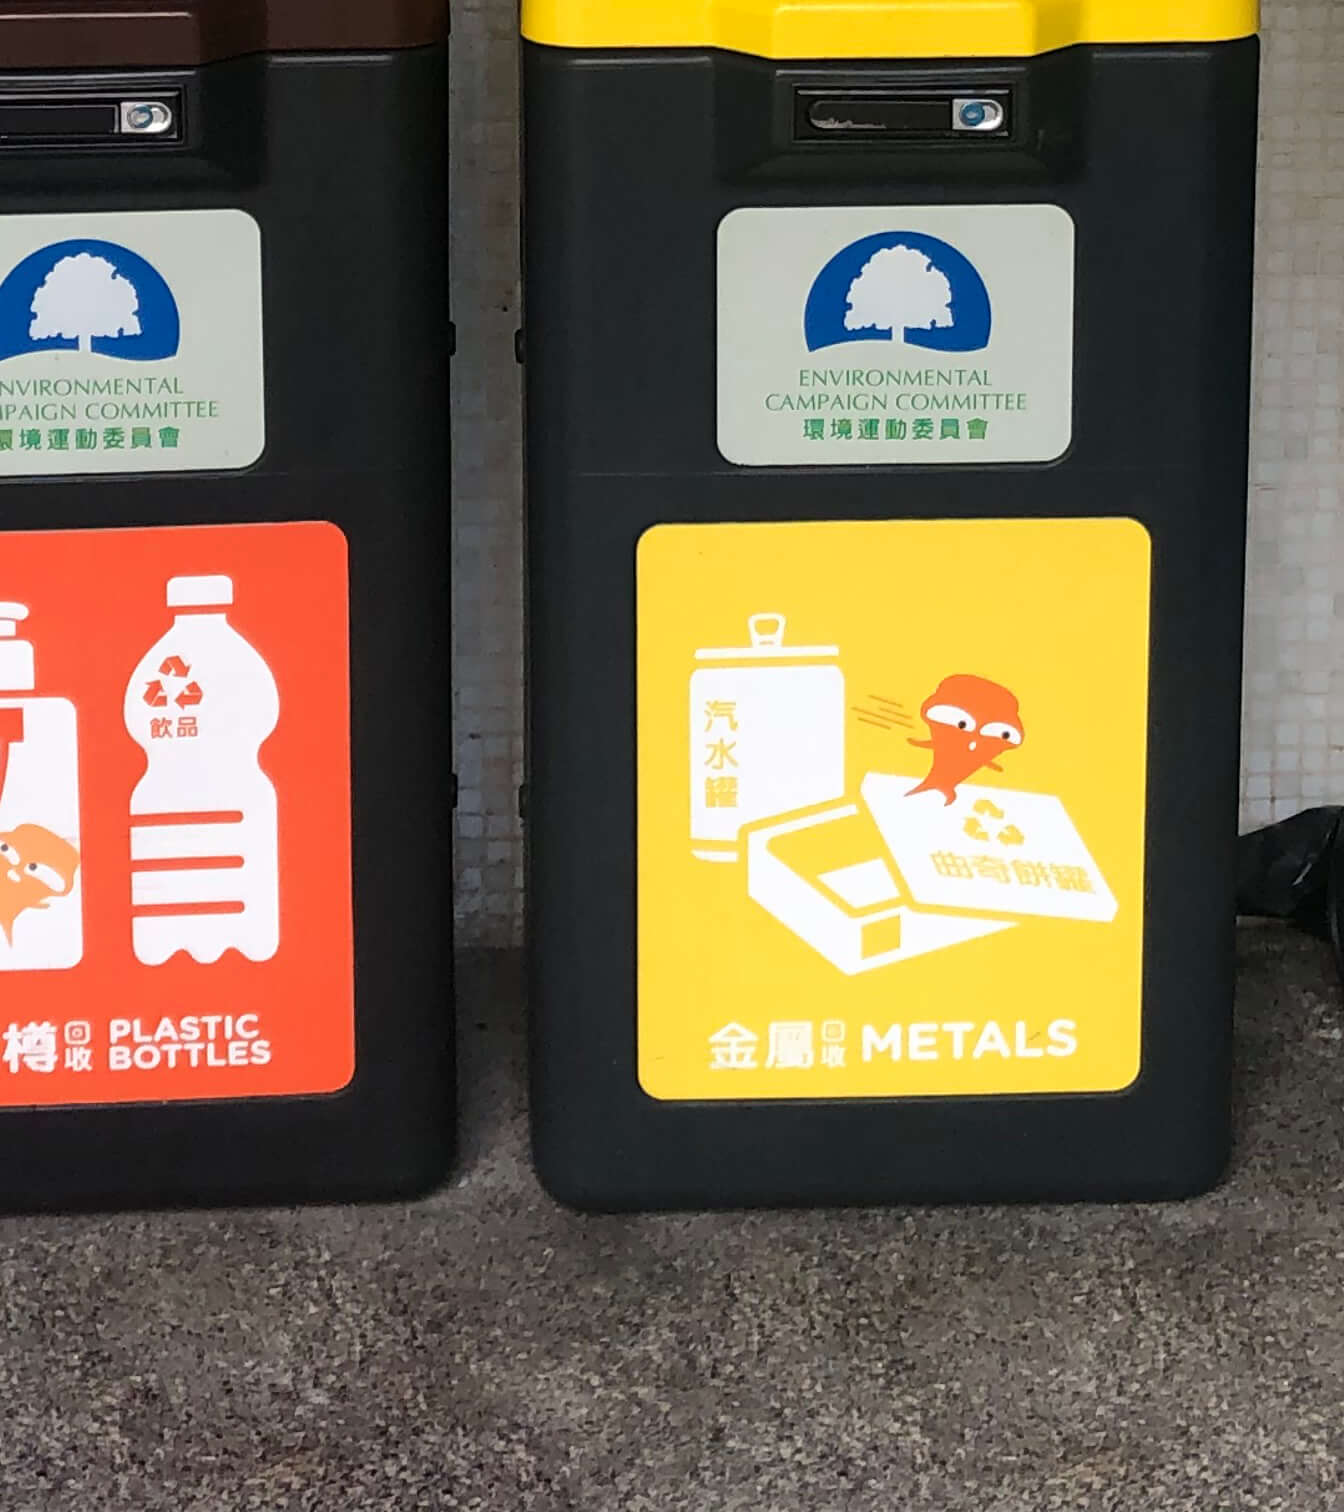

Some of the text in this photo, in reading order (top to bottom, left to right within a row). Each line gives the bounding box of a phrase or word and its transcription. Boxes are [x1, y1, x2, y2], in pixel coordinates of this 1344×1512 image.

[799, 369, 992, 387] ENVIRONMENTAL
[85, 401, 218, 420] COMMITTEE
[765, 392, 1027, 411] CAMPAIGN COMMITTEE
[803, 417, 989, 441] 環境運動委員會
[150, 716, 198, 739] 飲品
[704, 700, 739, 808] 汽水罐
[930, 850, 1096, 894] 曲奇餅罐
[109, 1014, 259, 1043] PLASTIC
[861, 1020, 1078, 1062] METALS
[108, 1040, 272, 1070] BOTTLES
[708, 1021, 815, 1070] 金屬
